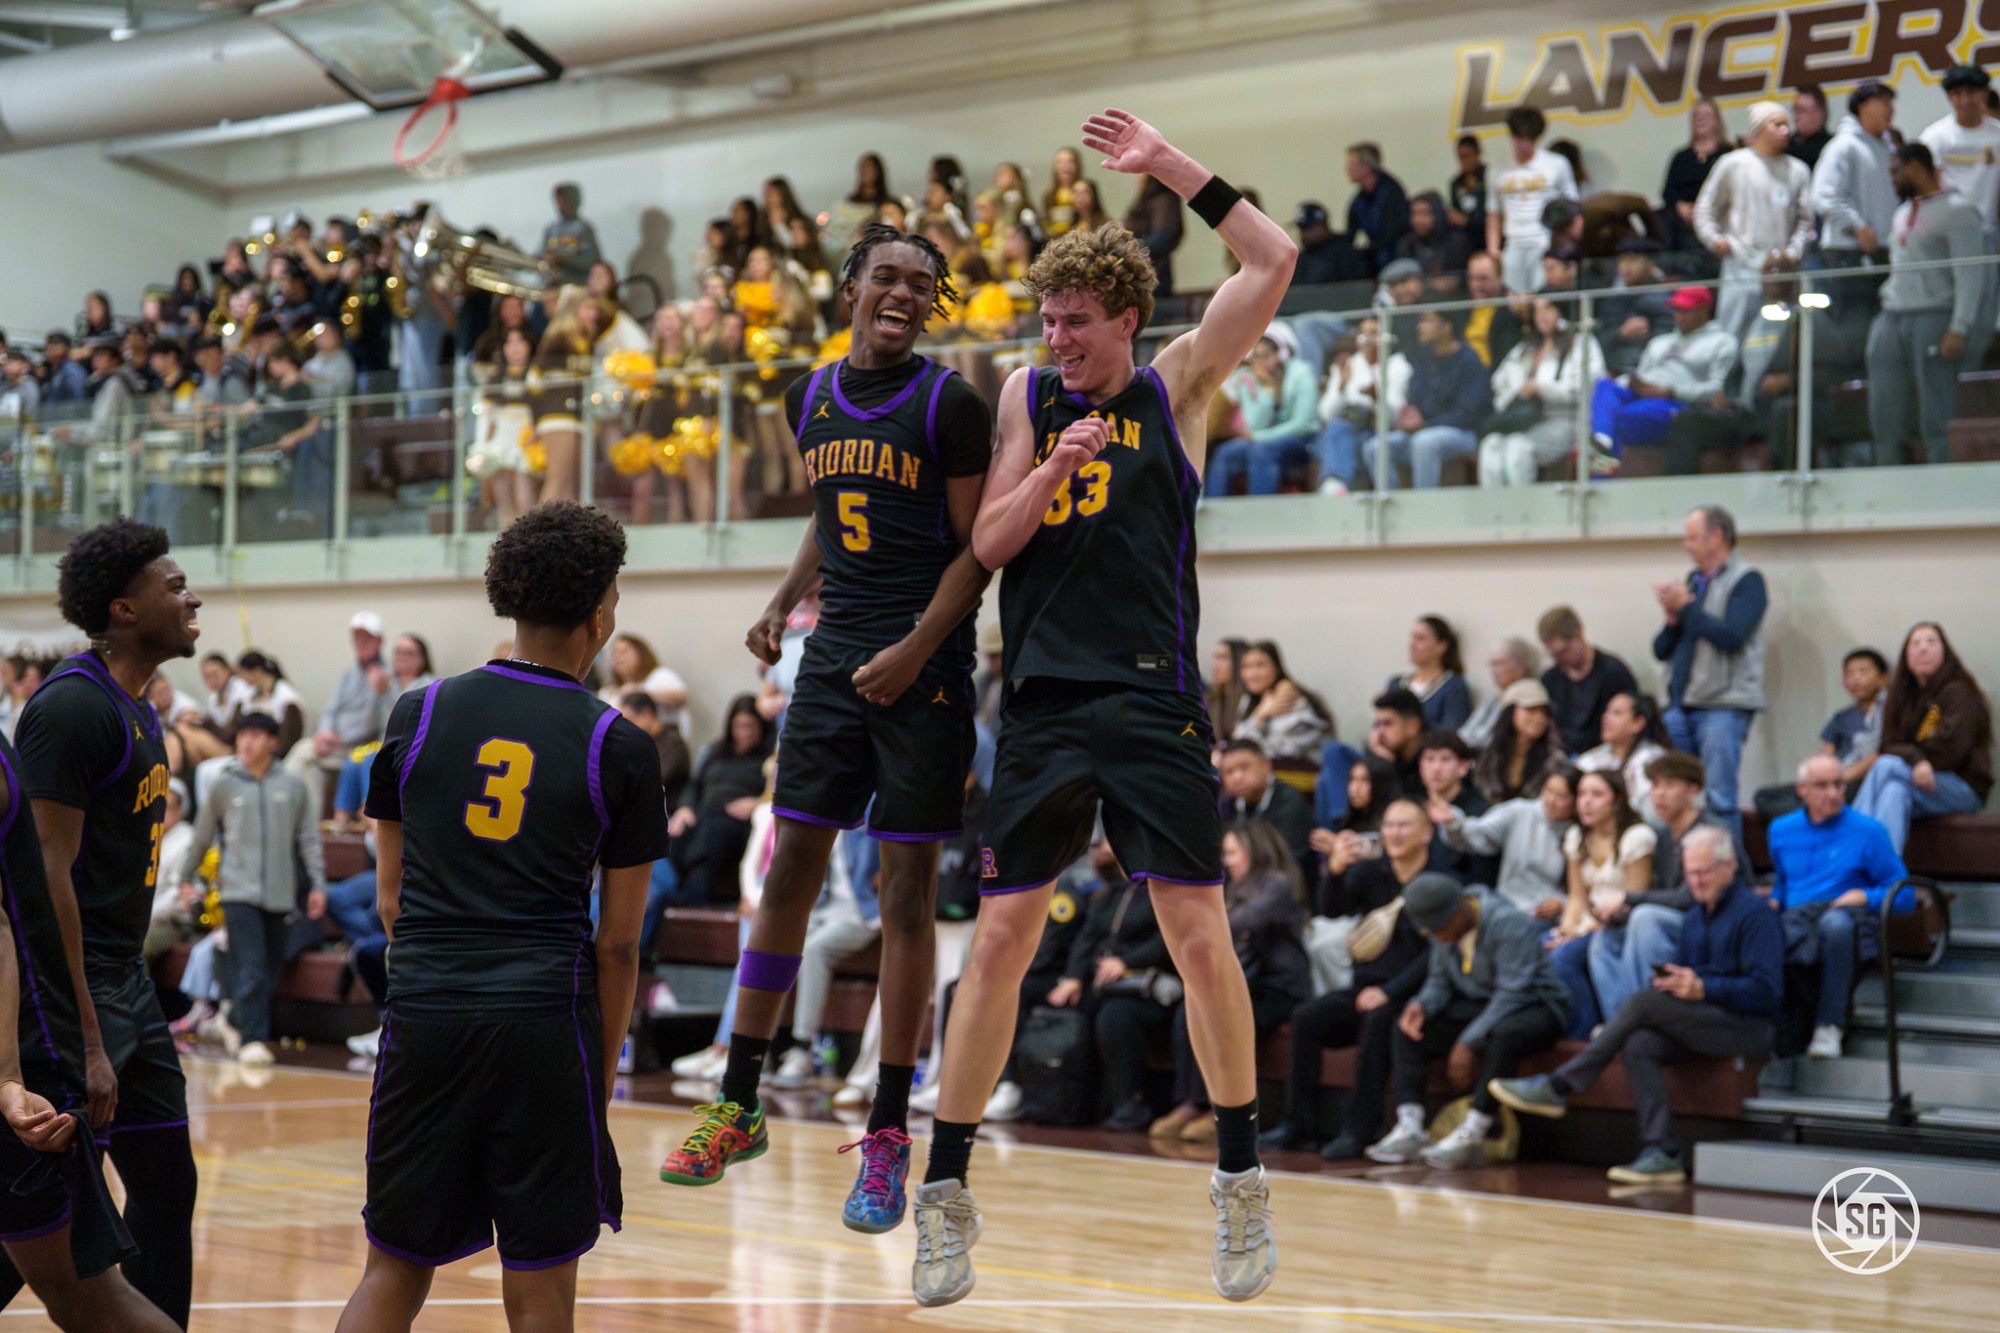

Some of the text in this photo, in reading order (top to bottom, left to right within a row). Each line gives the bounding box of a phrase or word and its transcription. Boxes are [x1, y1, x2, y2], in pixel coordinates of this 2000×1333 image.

[1453, 0, 2000, 133] LANCER
[804, 438, 921, 491] RIORDAN
[1043, 460, 1112, 526] 33
[837, 491, 872, 553] 5
[464, 737, 536, 842] 3
